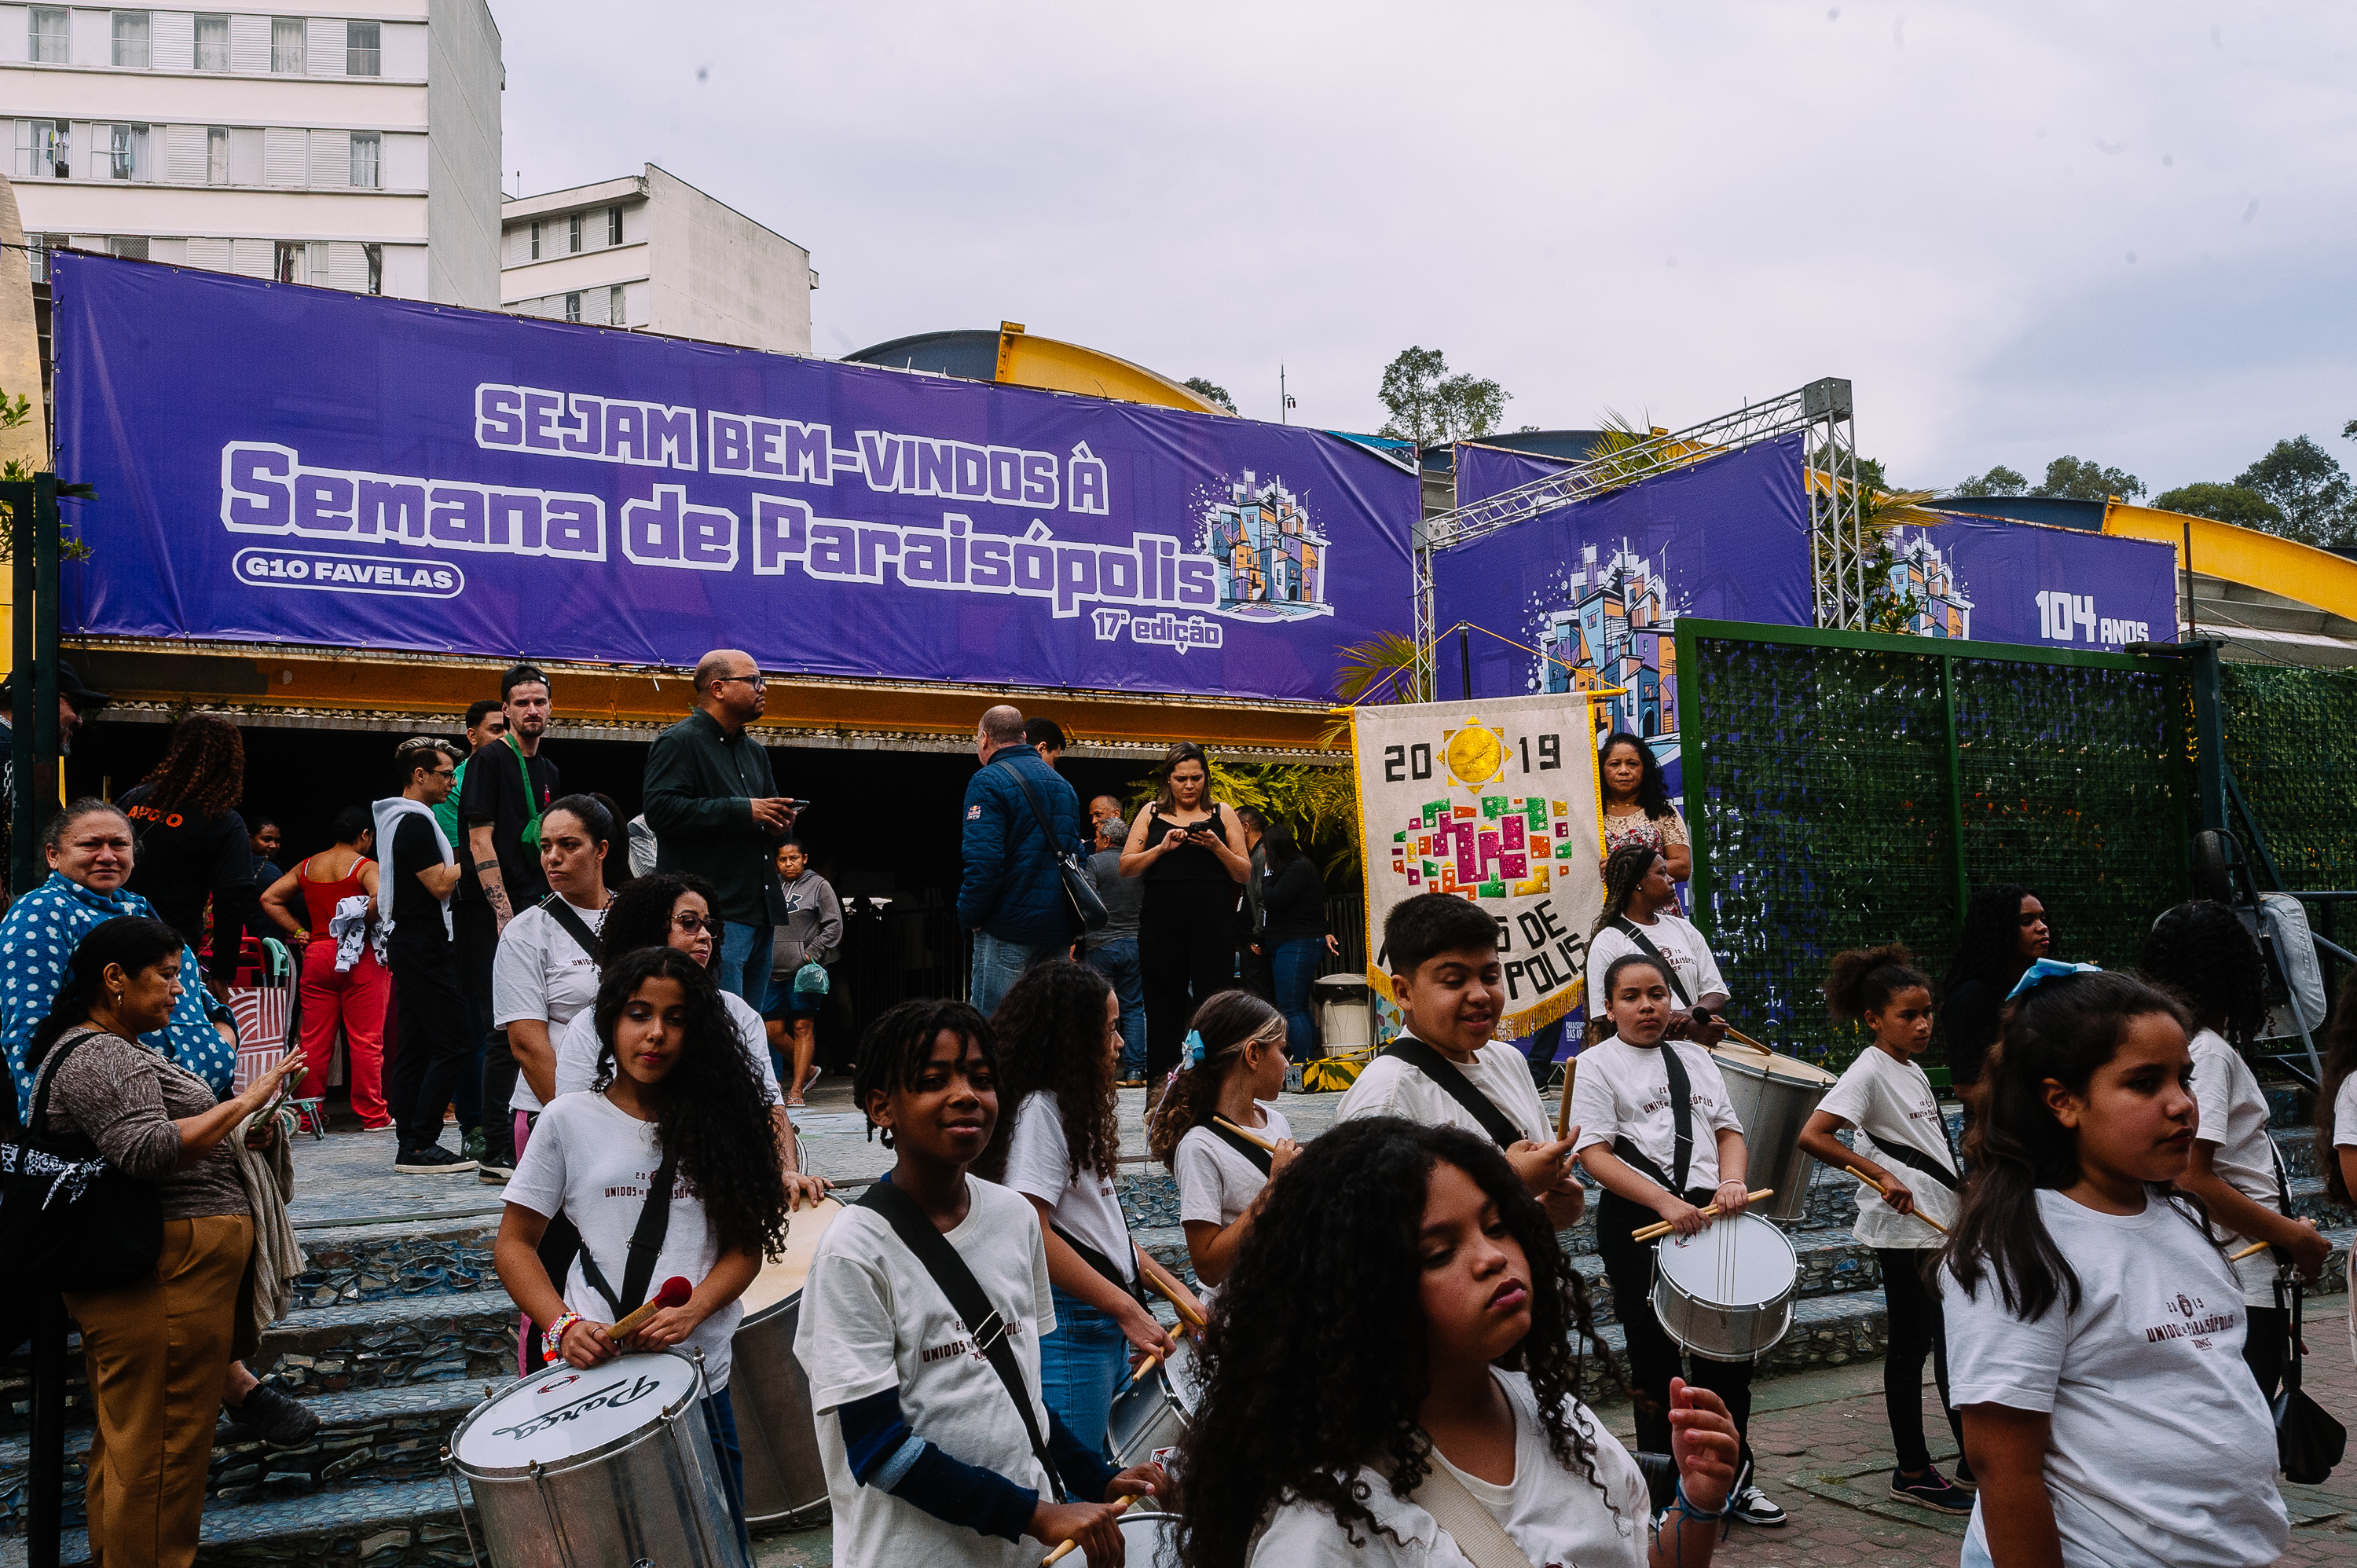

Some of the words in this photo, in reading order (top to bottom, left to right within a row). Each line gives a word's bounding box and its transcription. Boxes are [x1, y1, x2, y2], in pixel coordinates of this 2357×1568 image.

[475, 383, 698, 471] SEJAM
[709, 410, 1059, 511] BEM-VINDOS
[1068, 439, 1109, 515] À
[221, 441, 607, 562] Semana
[621, 484, 739, 571] de
[751, 493, 1222, 619] Paraisópolis
[246, 557, 310, 579] G10
[315, 562, 453, 588] FAVELAS
[1131, 613, 1223, 655] edição
[2035, 590, 2097, 643] 104
[2100, 617, 2150, 645] ANOS
[1384, 743, 1432, 782] 20
[1519, 734, 1562, 774] 19
[127, 805, 182, 827] APOO
[1516, 899, 1568, 950] DE
[1500, 932, 1587, 1000] POLIS
[604, 1186, 637, 1198] UNIDOS
[922, 1340, 966, 1363] UNIDOS
